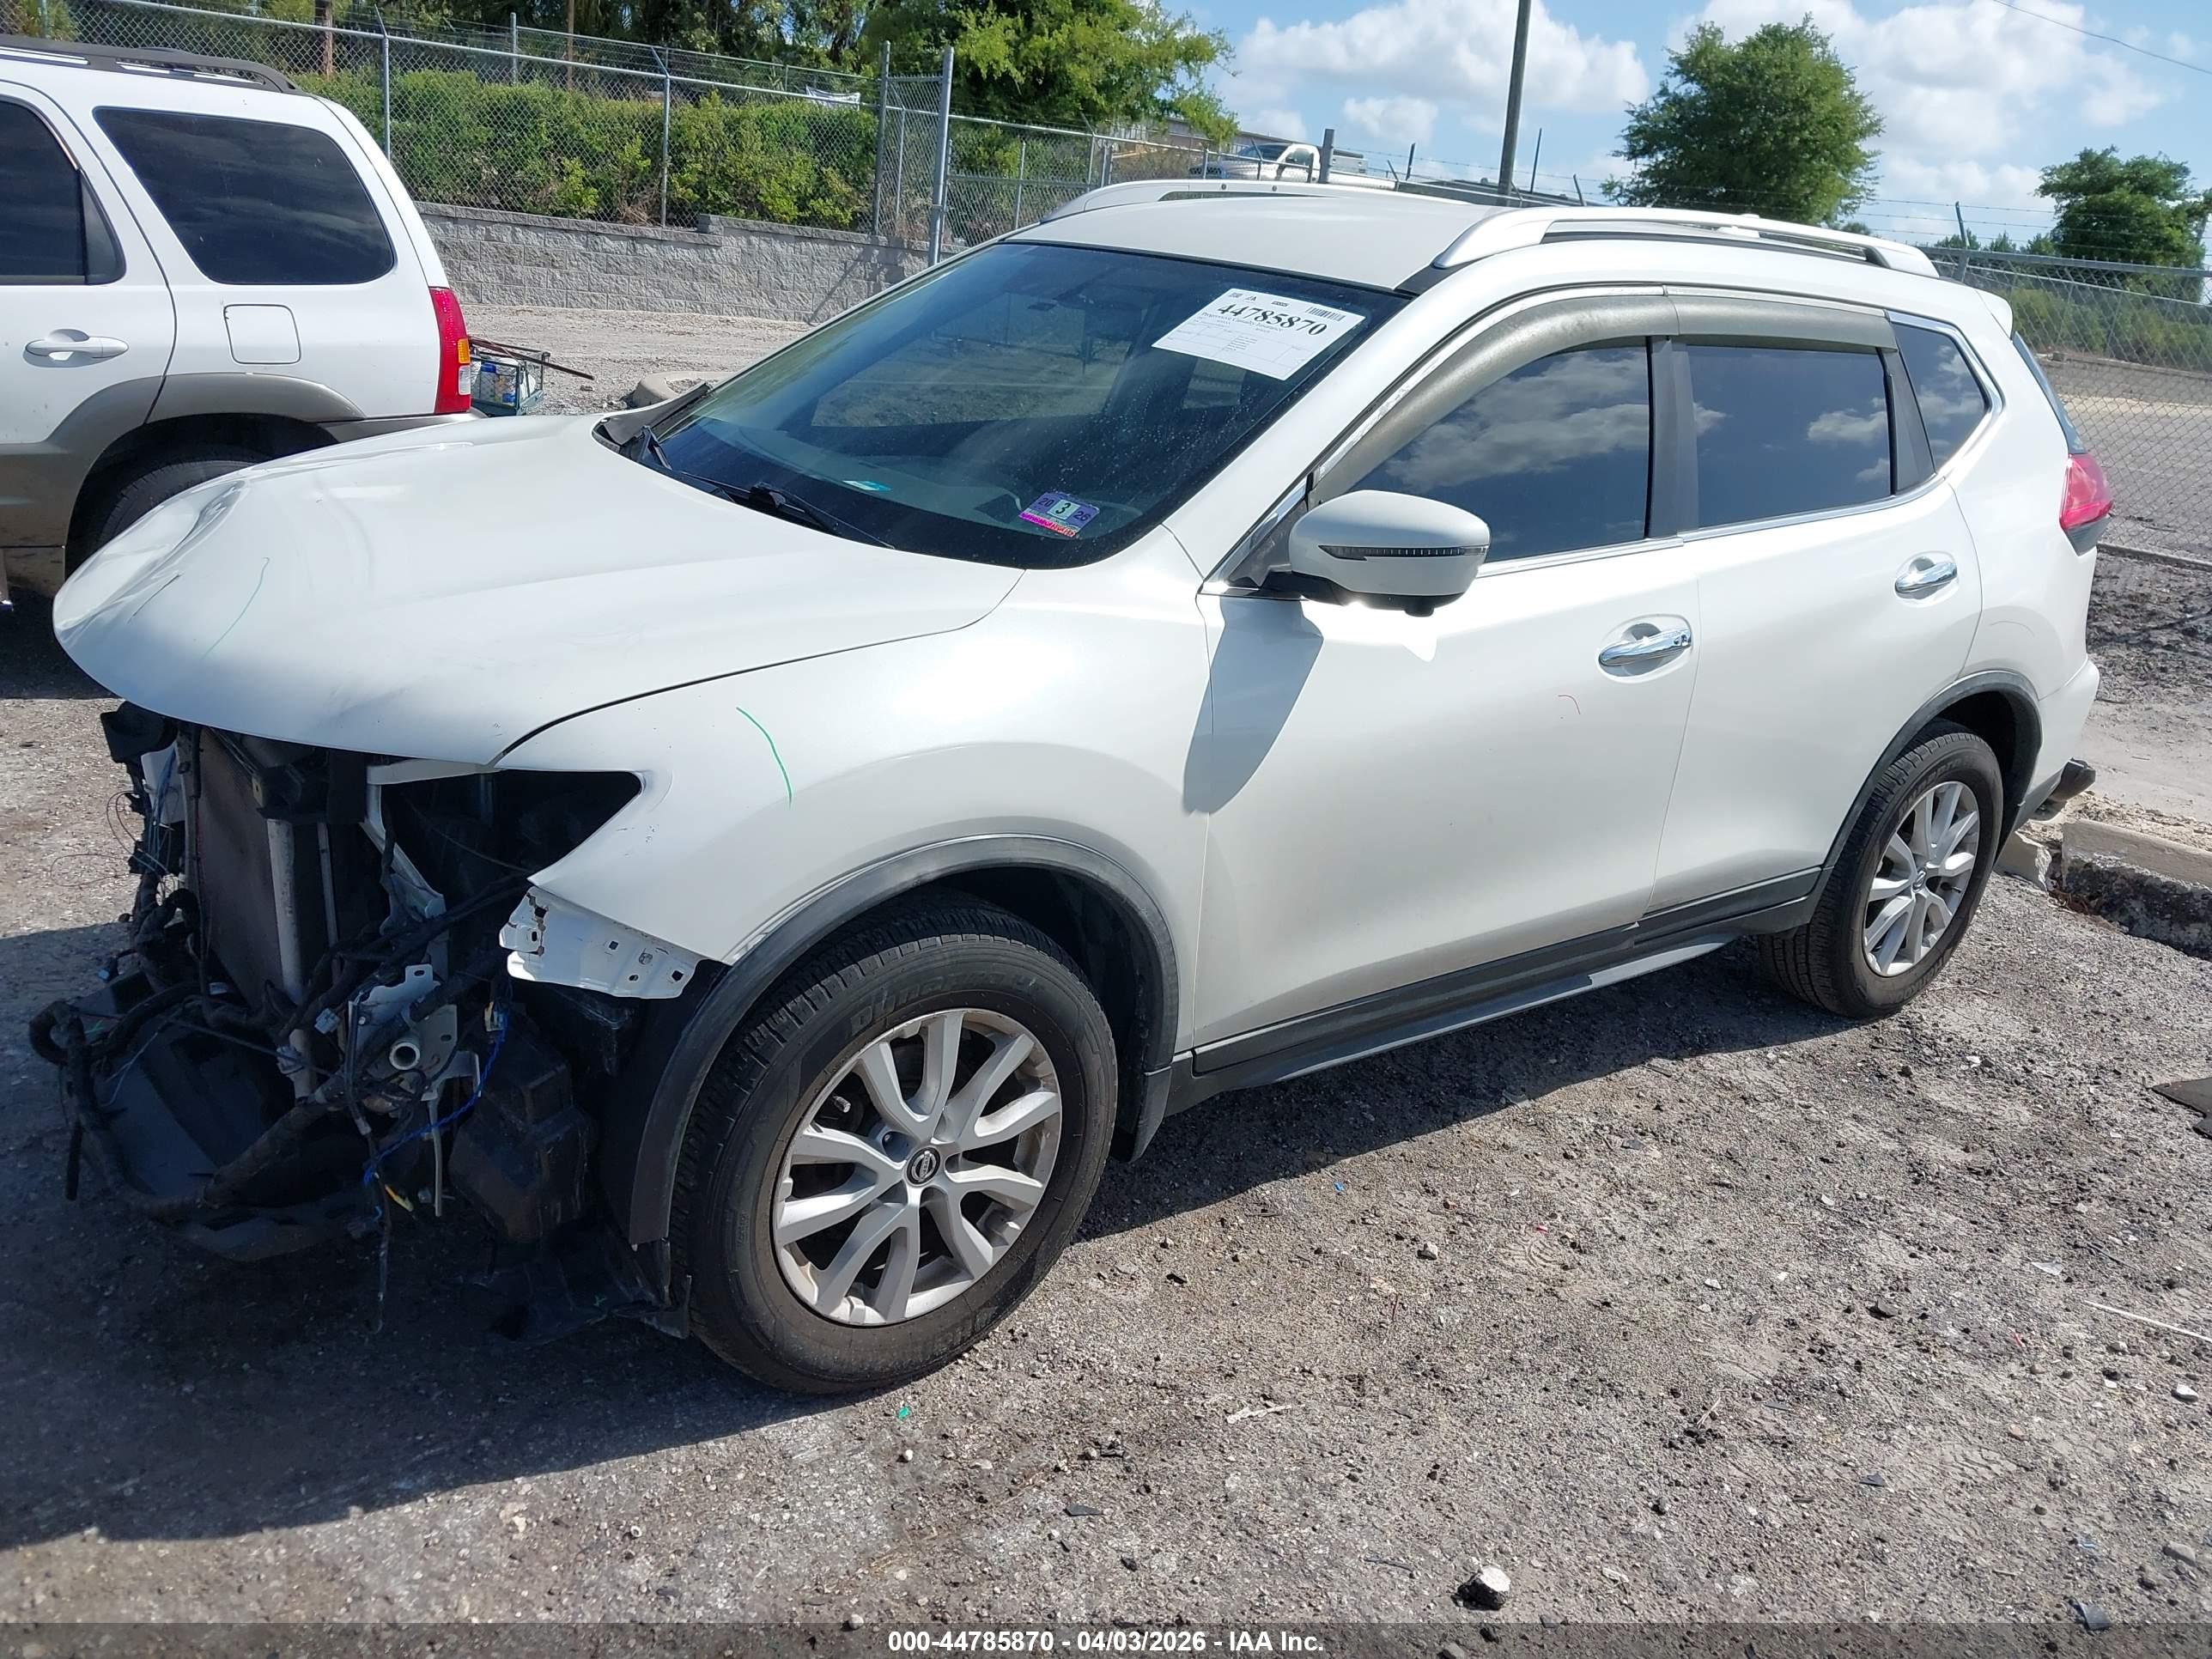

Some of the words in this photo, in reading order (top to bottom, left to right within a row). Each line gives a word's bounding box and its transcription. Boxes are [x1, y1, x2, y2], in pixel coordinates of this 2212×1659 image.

[1218, 303, 1327, 335] 44785870
[1037, 497, 1054, 507] 20
[1055, 502, 1071, 514] 3
[1073, 510, 1091, 521] 26
